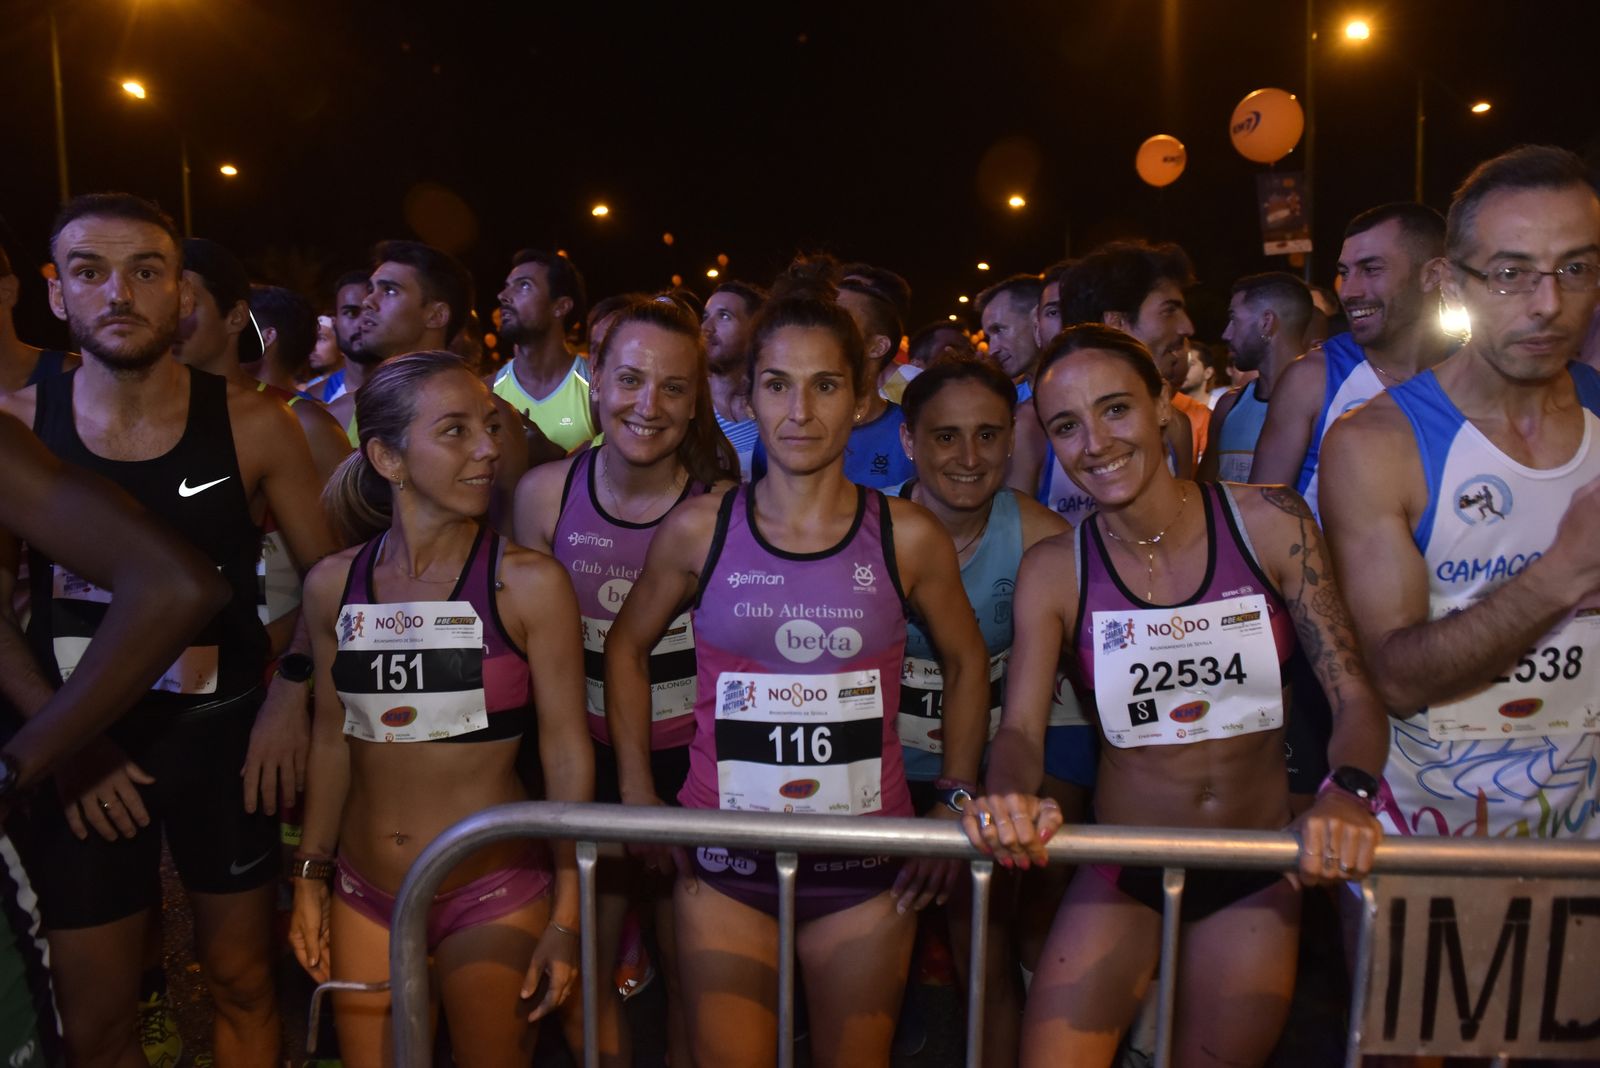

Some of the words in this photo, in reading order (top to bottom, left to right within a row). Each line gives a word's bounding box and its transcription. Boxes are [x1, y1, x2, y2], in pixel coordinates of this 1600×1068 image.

[572, 559, 602, 575] Club
[733, 602, 774, 618] Club
[778, 602, 864, 619] Atletismo
[786, 629, 852, 651] betta
[370, 652, 424, 691] 151
[1129, 653, 1247, 696] 22534
[1491, 646, 1583, 683] 538
[656, 679, 692, 692] ALONSO
[768, 725, 833, 763] 116
